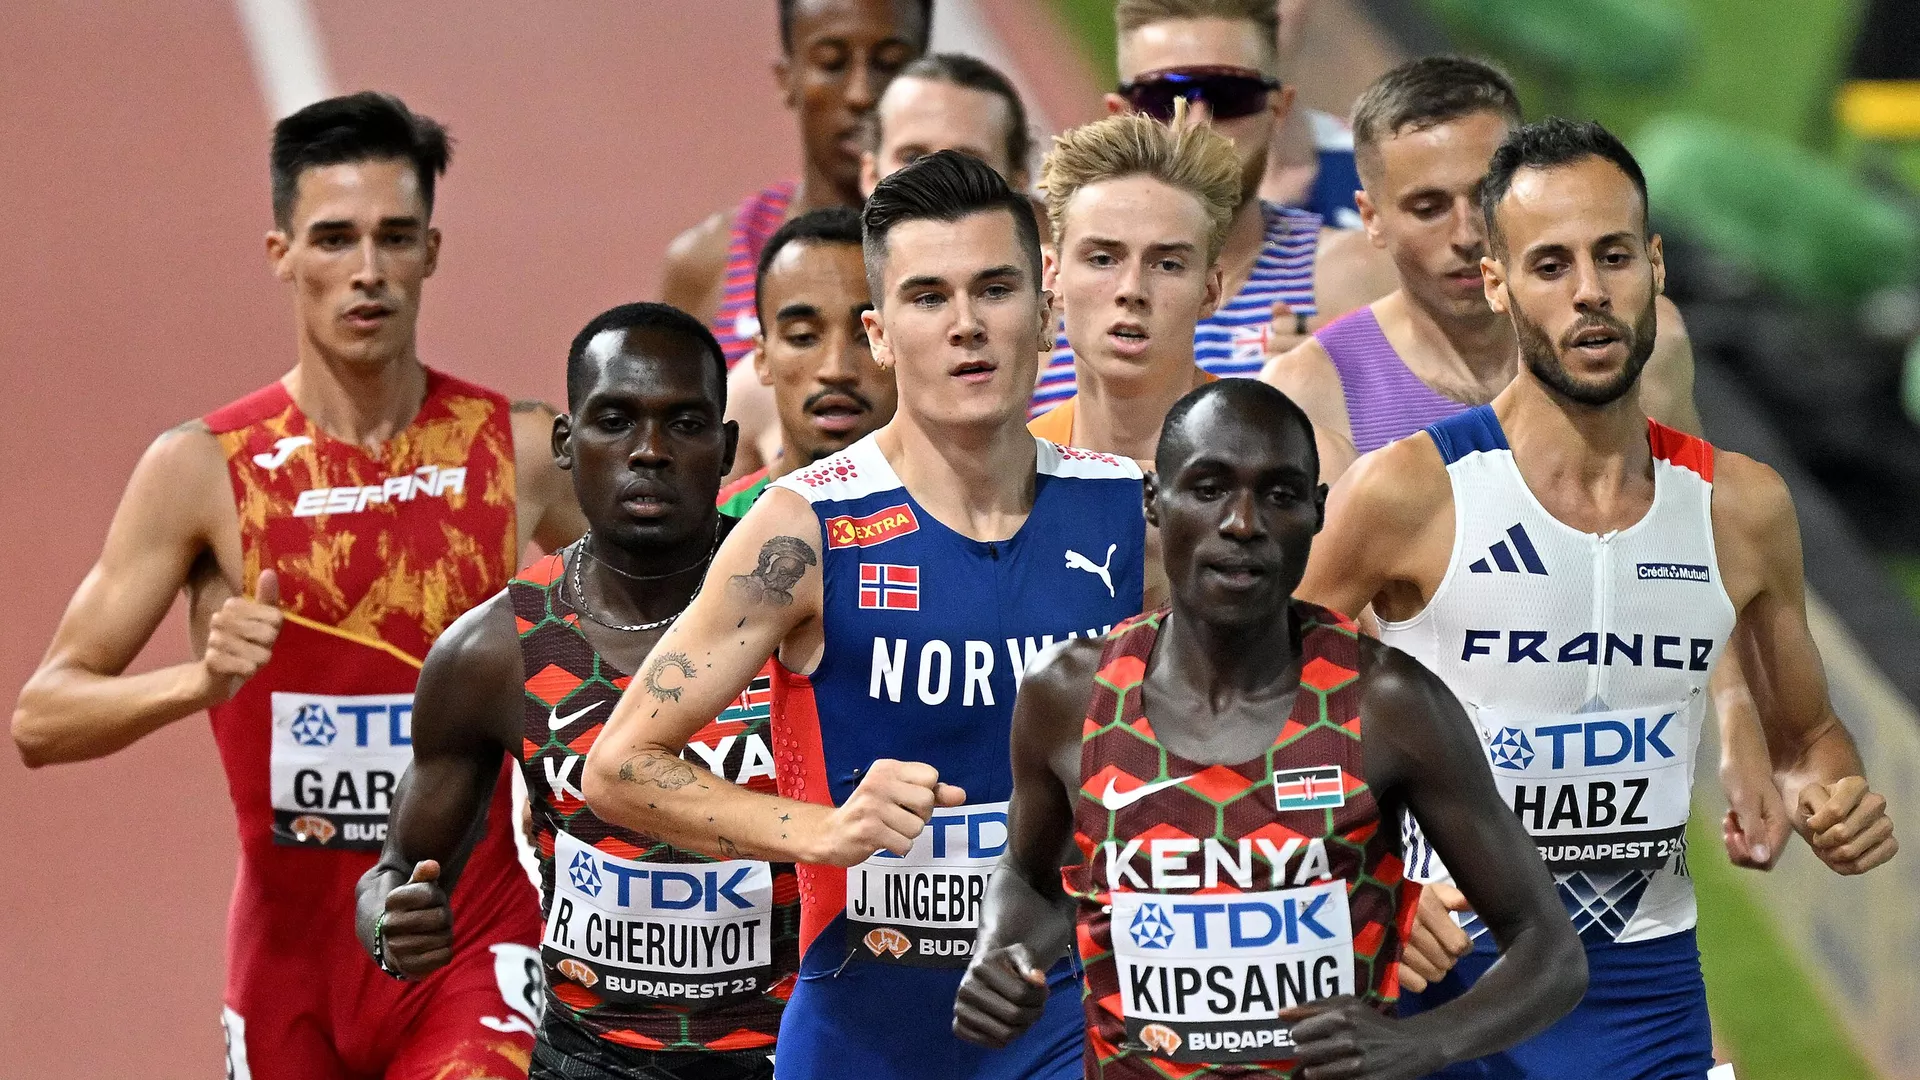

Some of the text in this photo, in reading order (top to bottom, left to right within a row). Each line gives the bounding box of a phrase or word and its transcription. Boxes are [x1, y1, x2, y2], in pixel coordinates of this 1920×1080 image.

[293, 465, 467, 517] ESPAÑA
[855, 513, 910, 539] EXTRA
[1639, 566, 1708, 580] Crédit Mutuel
[869, 624, 1111, 706] NORW
[1461, 629, 1713, 671] FRANCE
[1535, 712, 1677, 770] TDK
[543, 734, 776, 802] KYA
[1514, 778, 1649, 830] HABZ
[603, 866, 755, 912] TDK
[1104, 838, 1333, 890] KENYA
[854, 870, 992, 923] J. INGEBR
[1173, 892, 1336, 949] TDK
[553, 897, 760, 968] R. CHERUIYOT
[605, 975, 757, 999] BUDAPEST 23
[1129, 955, 1340, 1016] KIPSANG
